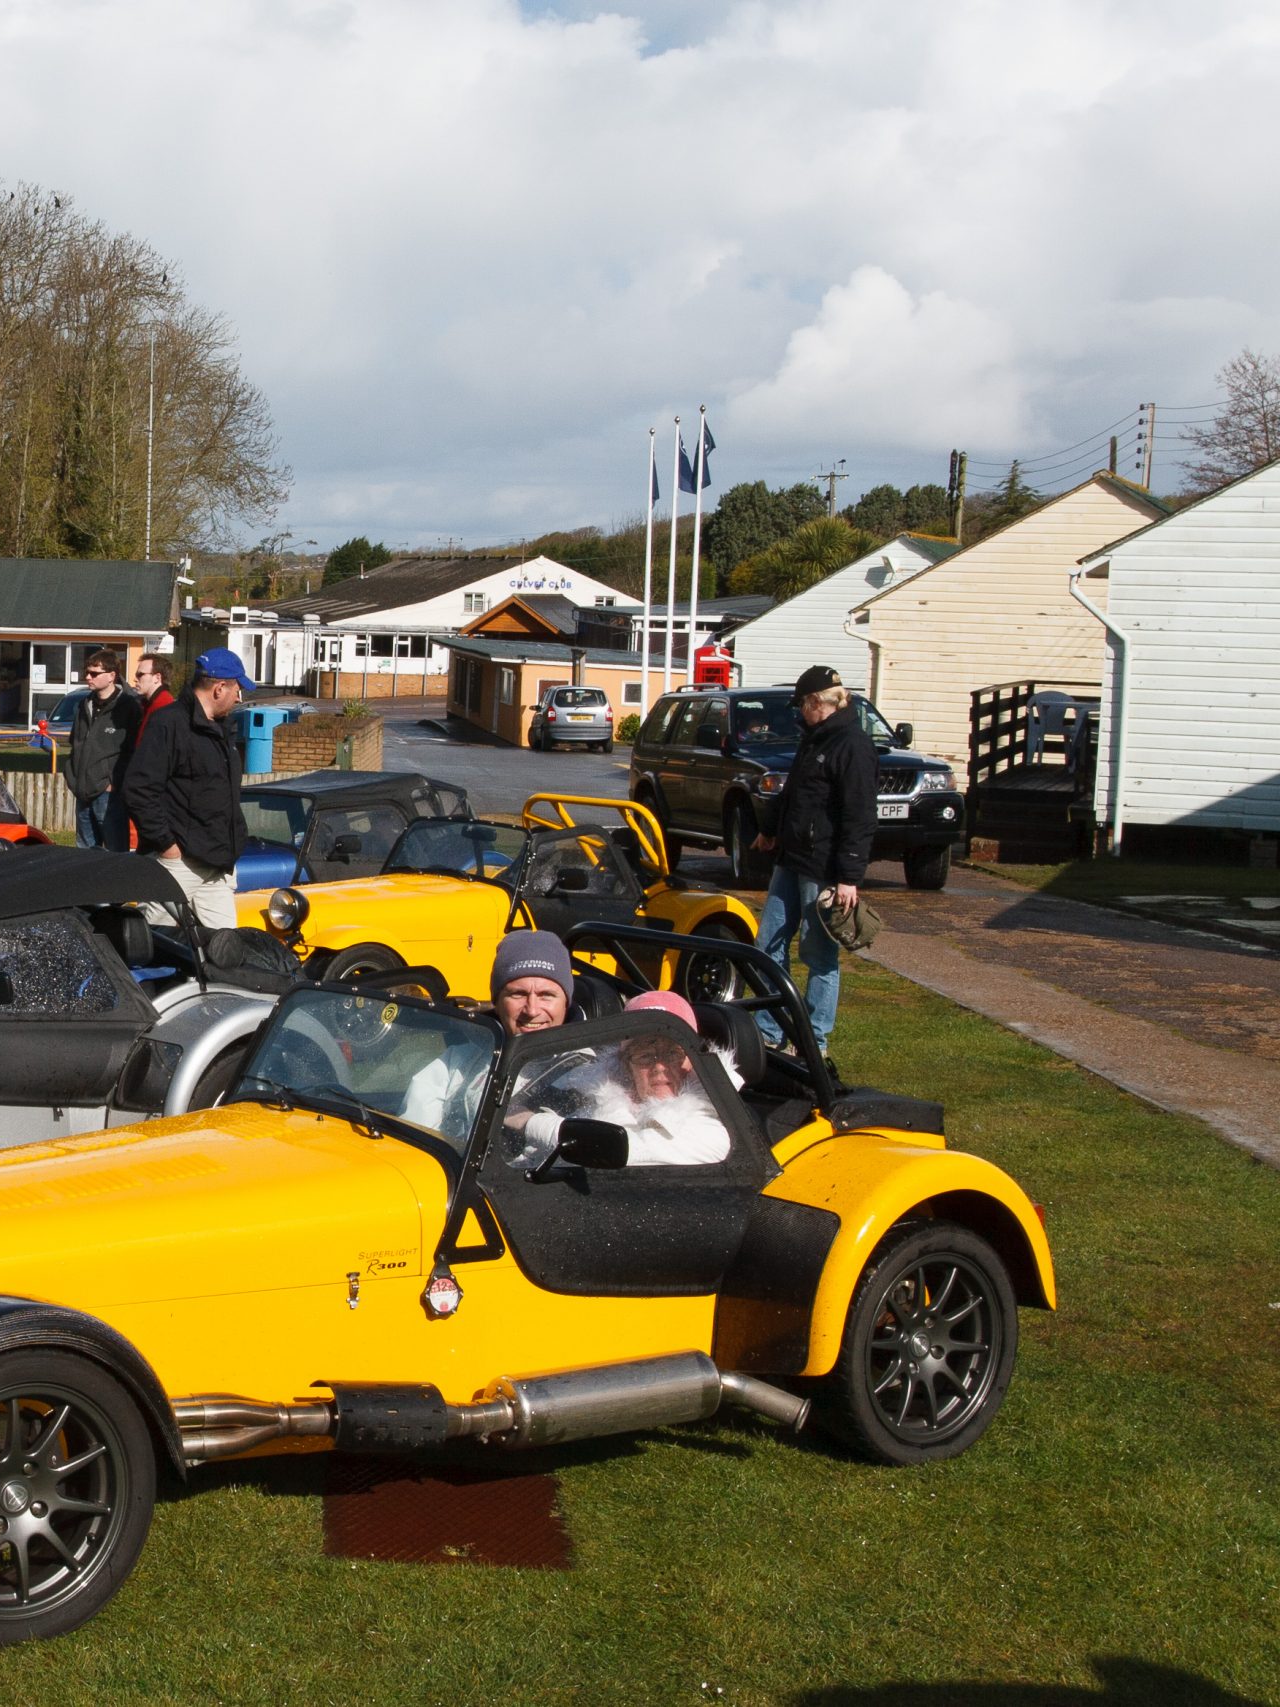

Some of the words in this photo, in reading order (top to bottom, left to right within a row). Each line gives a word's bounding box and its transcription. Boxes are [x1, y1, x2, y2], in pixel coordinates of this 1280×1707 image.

[881, 805, 904, 817] CPF
[358, 1248, 418, 1260] SUPERLIGHT
[366, 1259, 407, 1276] R300
